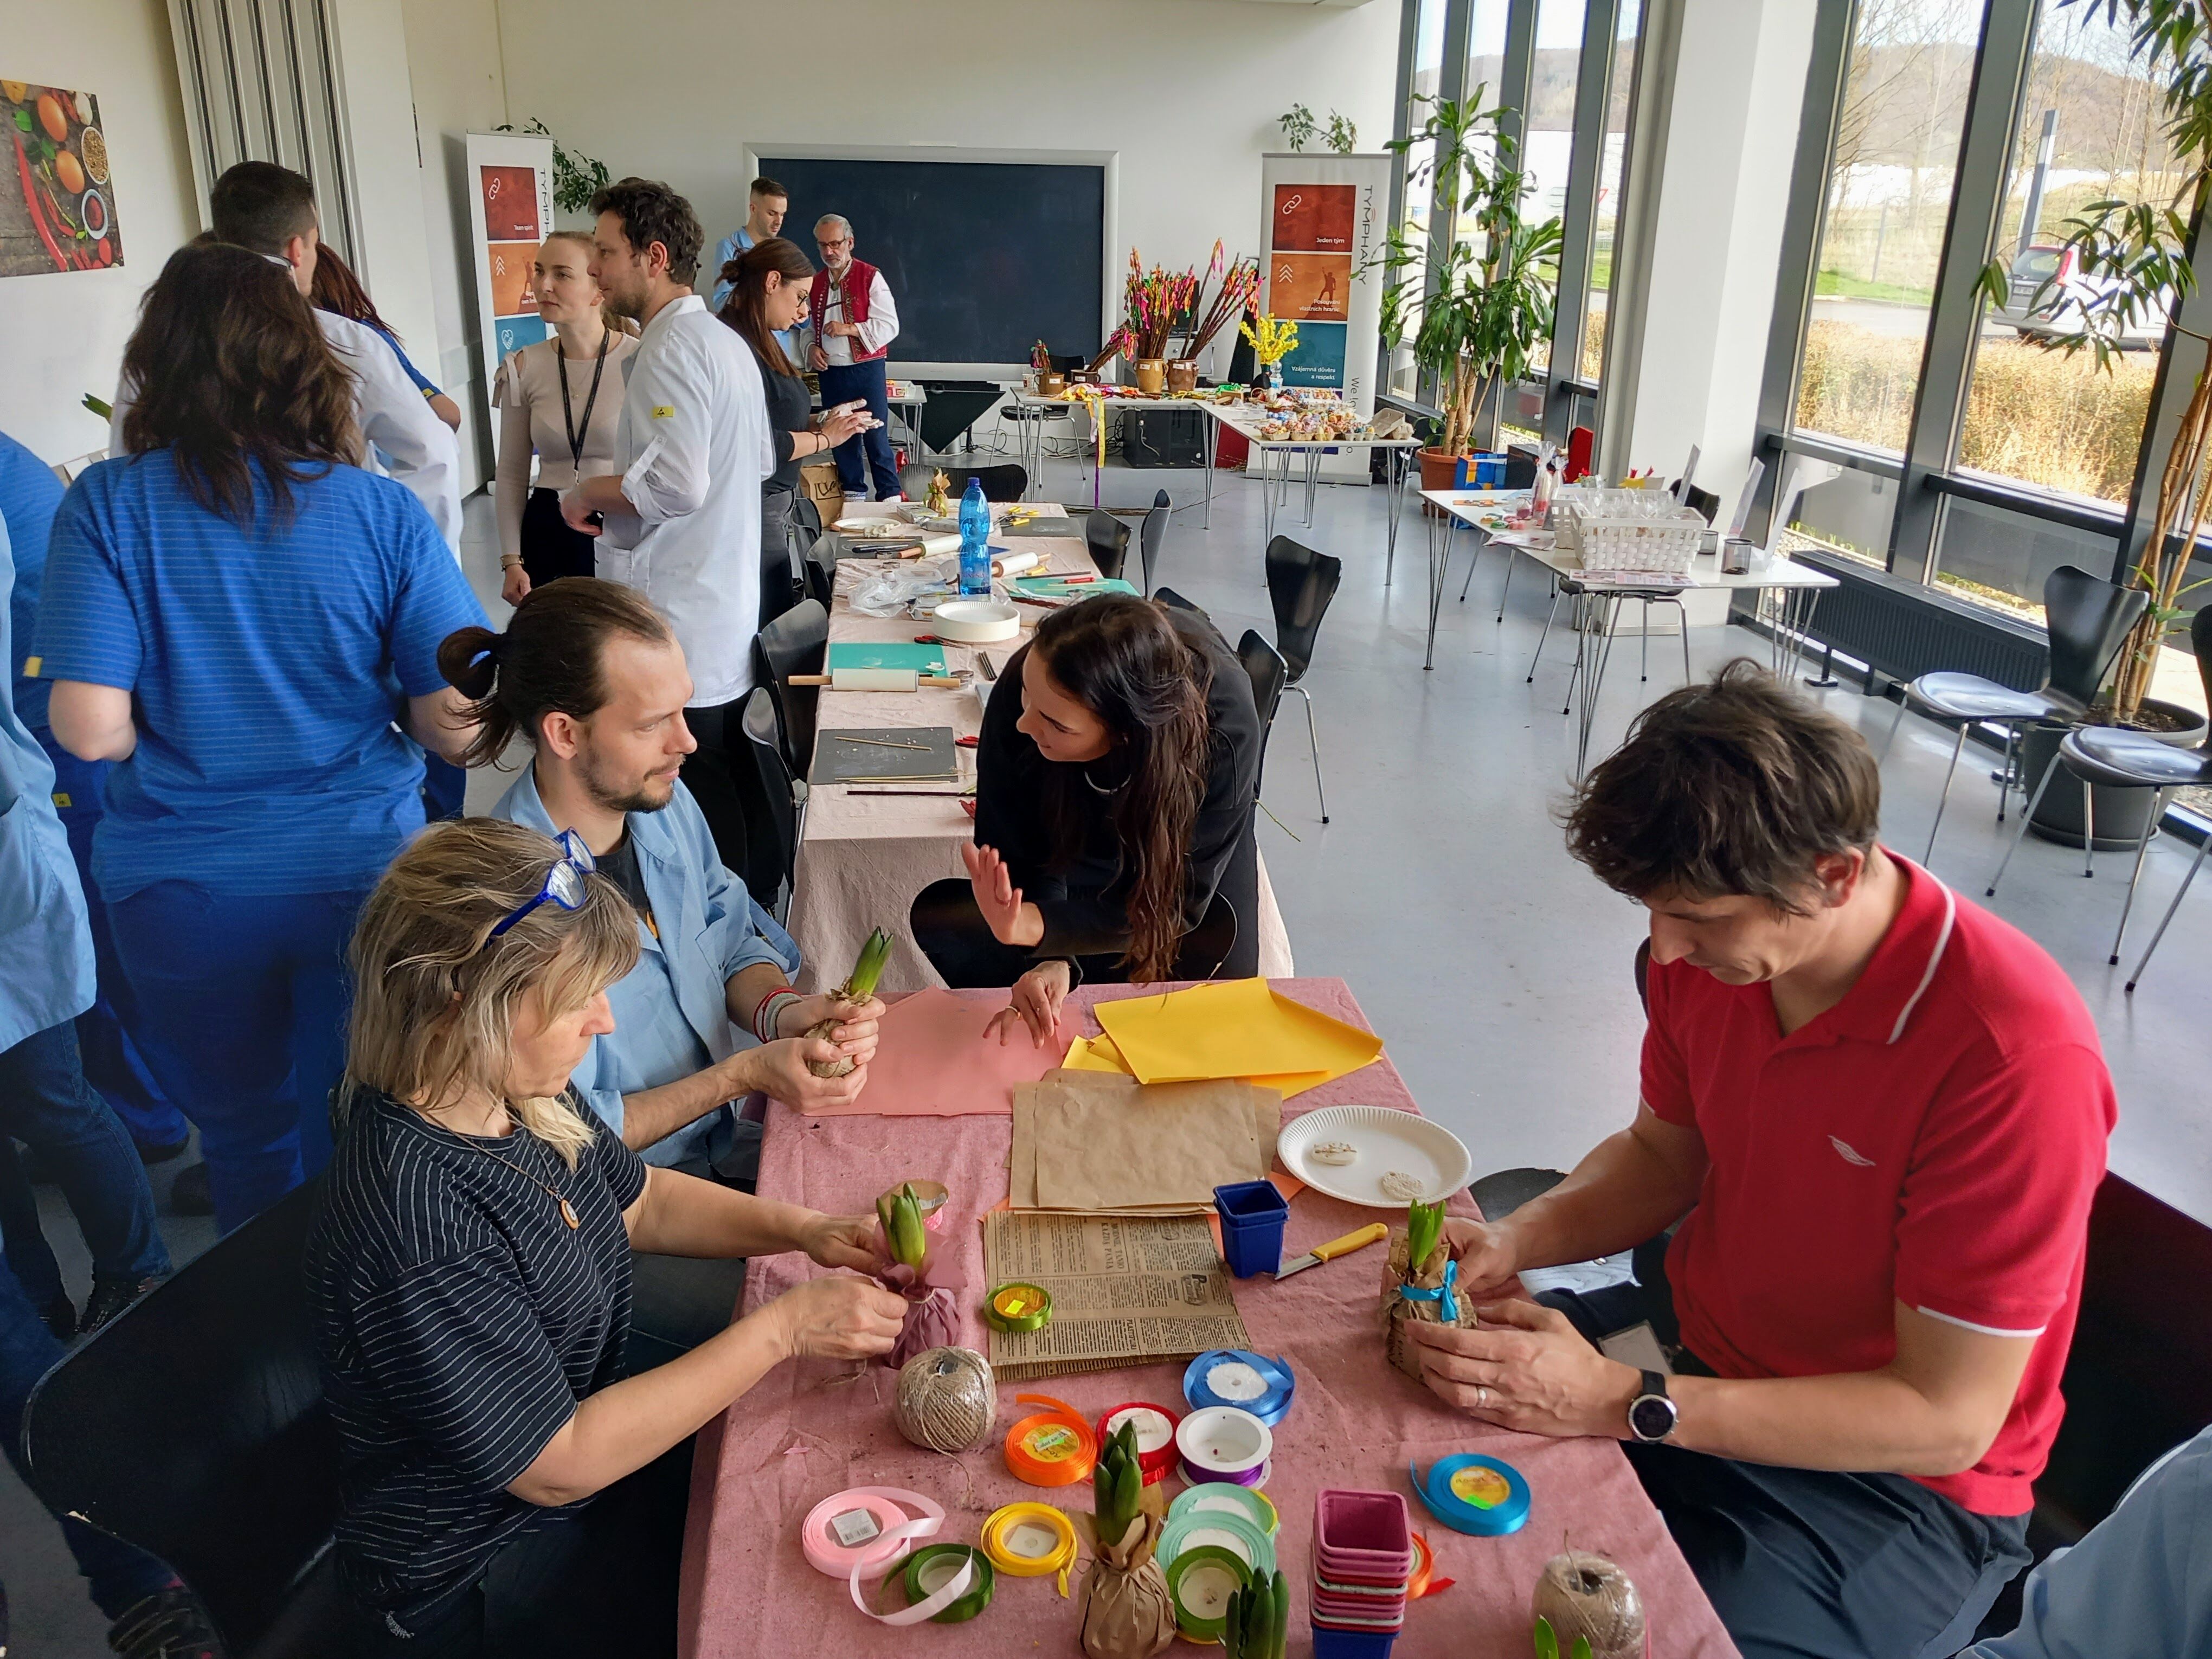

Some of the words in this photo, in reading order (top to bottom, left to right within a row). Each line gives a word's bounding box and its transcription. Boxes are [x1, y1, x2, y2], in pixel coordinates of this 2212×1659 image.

[541, 168, 550, 236] TYMPH
[1359, 185, 1373, 285] TYMPHANY
[1351, 377, 1360, 394] We
